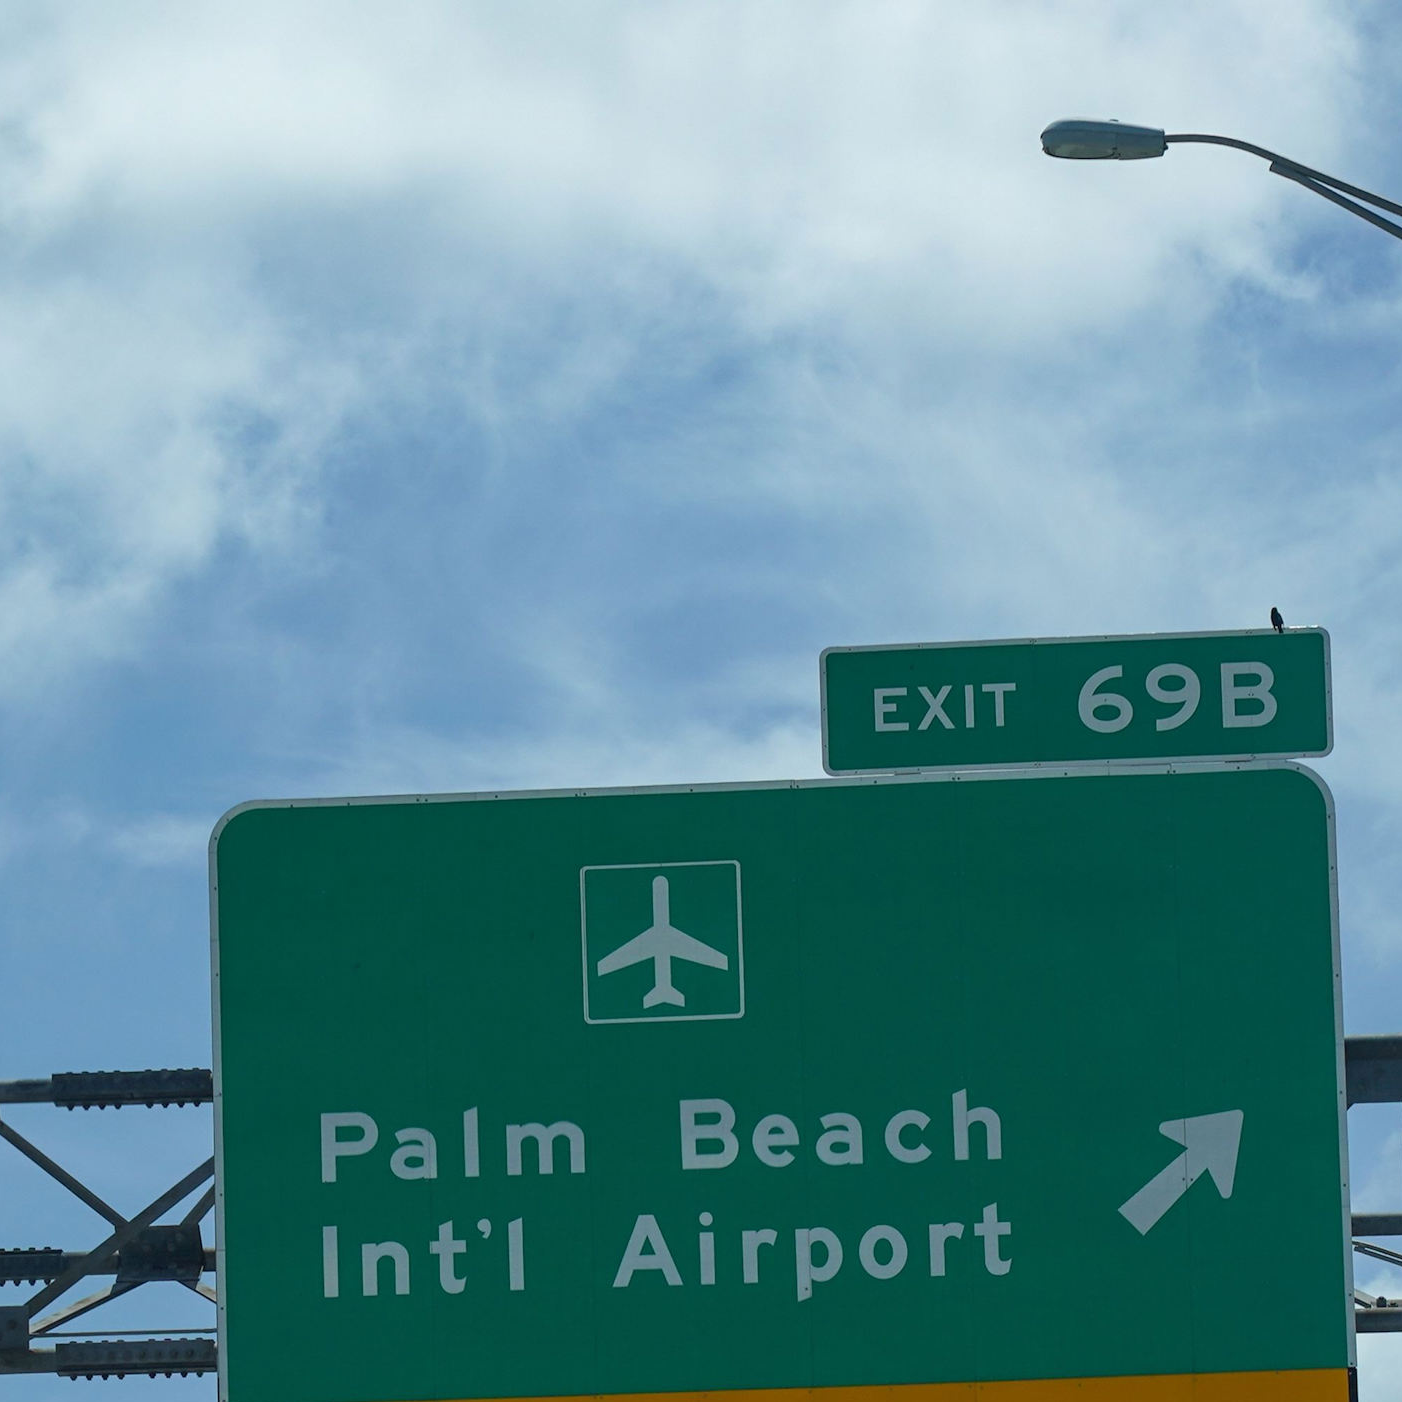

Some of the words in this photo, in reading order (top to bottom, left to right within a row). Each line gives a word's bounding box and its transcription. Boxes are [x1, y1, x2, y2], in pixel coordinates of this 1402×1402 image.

[874, 683, 1016, 731] EXIT
[1078, 662, 1277, 733] 69B
[321, 1107, 585, 1182] Palm
[680, 1089, 1001, 1169] Beach
[323, 1218, 524, 1297] Int'l
[613, 1203, 1011, 1301] Airport
